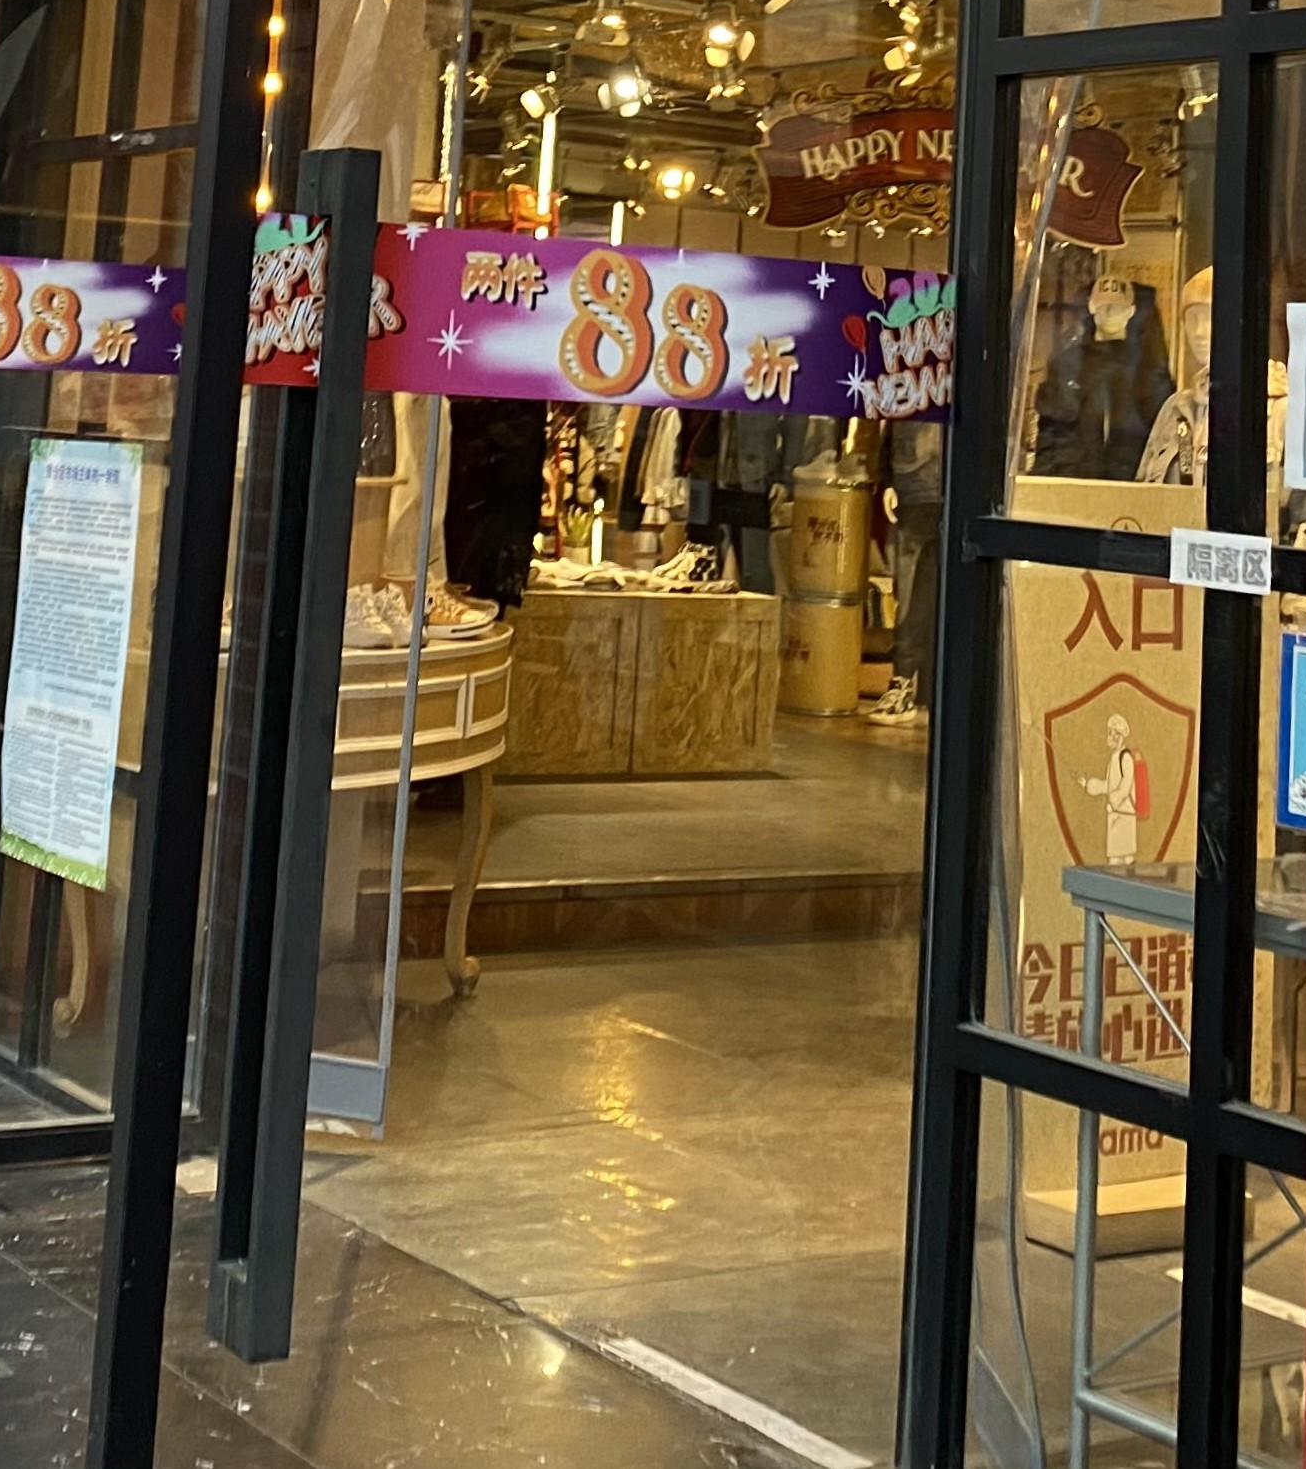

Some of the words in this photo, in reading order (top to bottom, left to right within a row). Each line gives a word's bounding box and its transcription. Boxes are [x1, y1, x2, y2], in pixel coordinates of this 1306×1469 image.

[799, 129, 905, 180] HAPPY
[916, 129, 955, 162] NE
[92, 319, 138, 368] 折
[461, 251, 547, 308] 两件
[558, 250, 730, 400] 88
[744, 335, 800, 404] 折
[1063, 571, 1184, 652] 入口
[1099, 1127, 1164, 1157] ama
